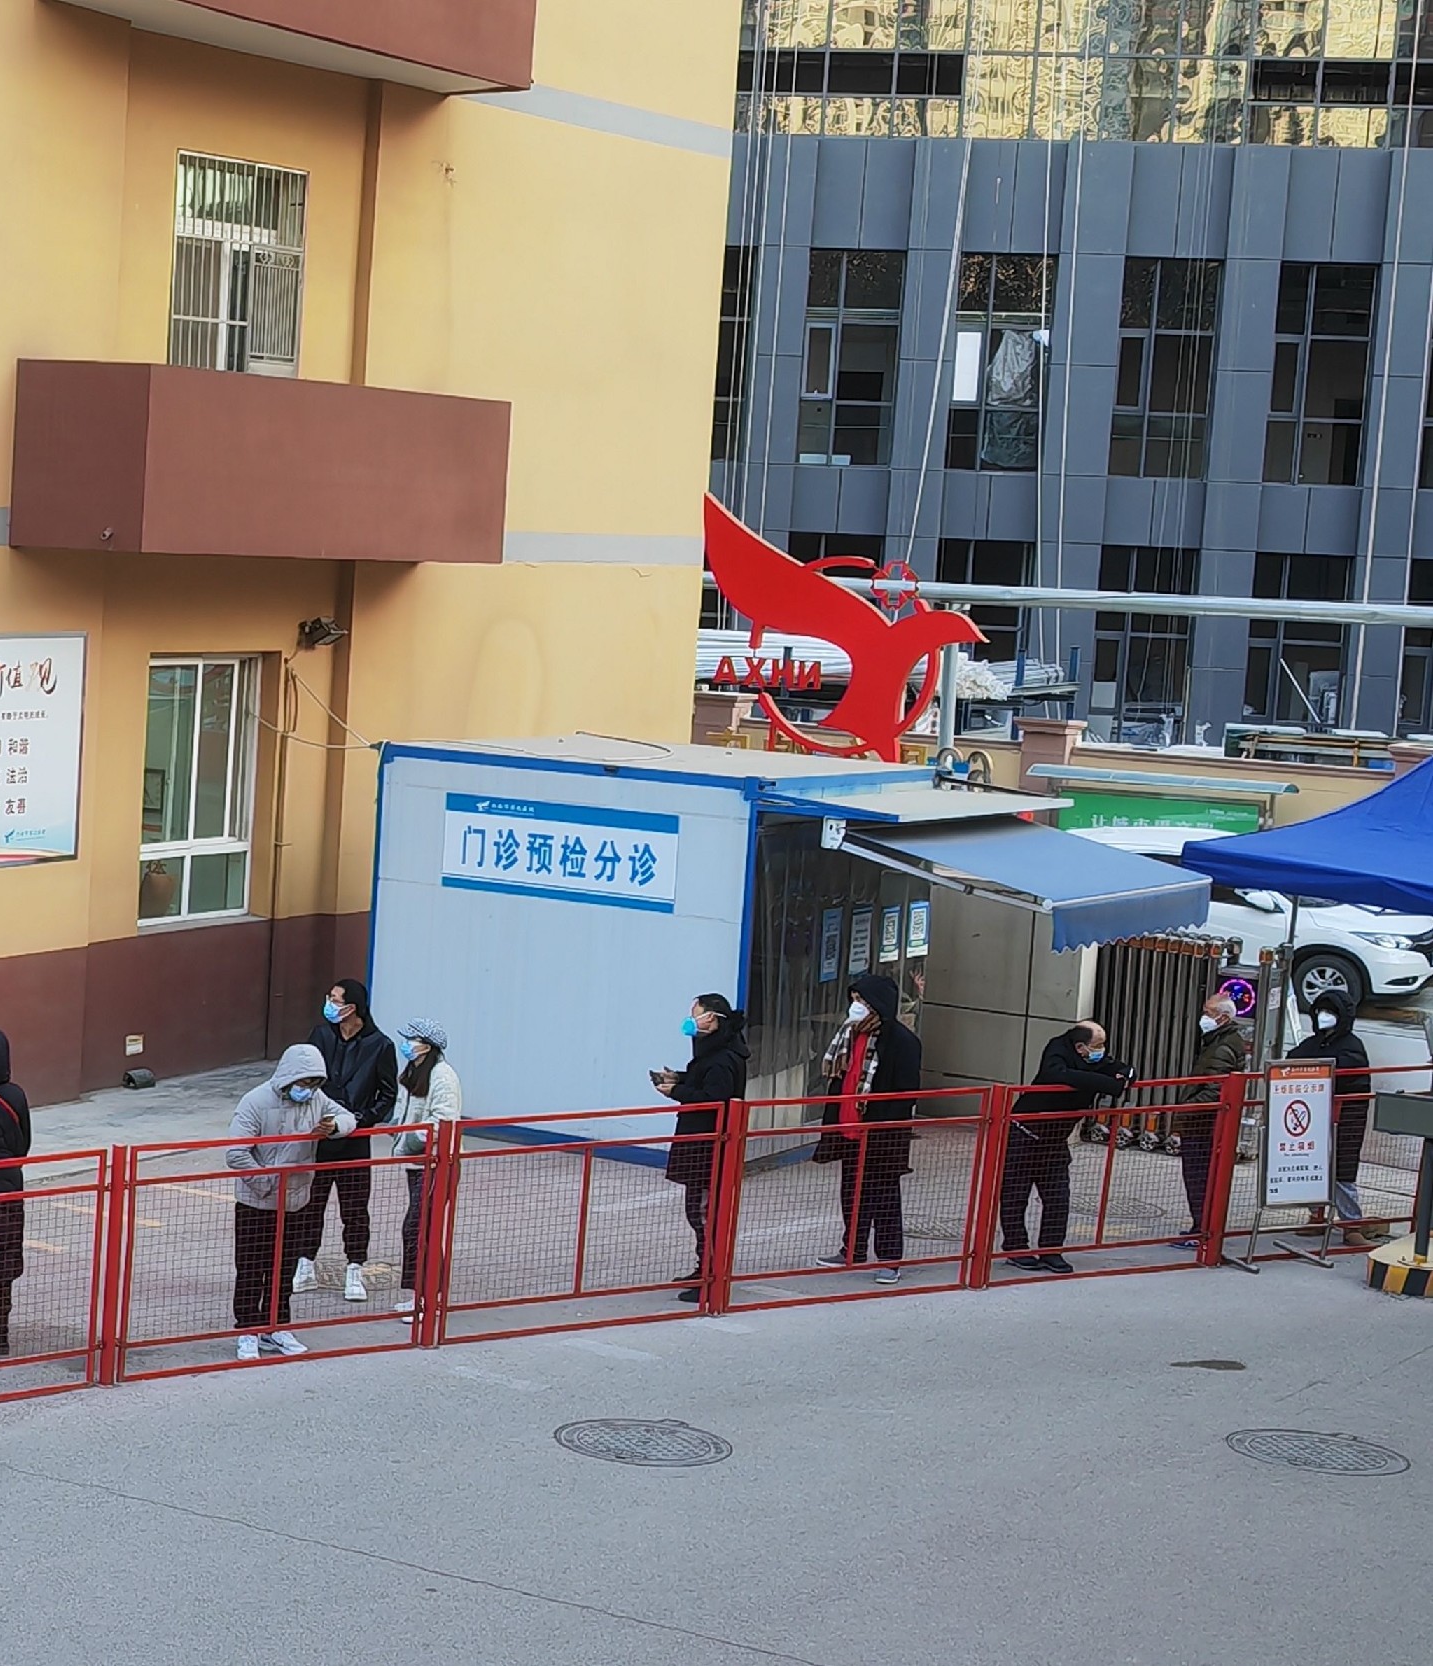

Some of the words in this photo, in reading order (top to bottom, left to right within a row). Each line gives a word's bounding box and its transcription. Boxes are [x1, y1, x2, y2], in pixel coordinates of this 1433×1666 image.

[461, 824, 658, 887] 门诊预检分诊
